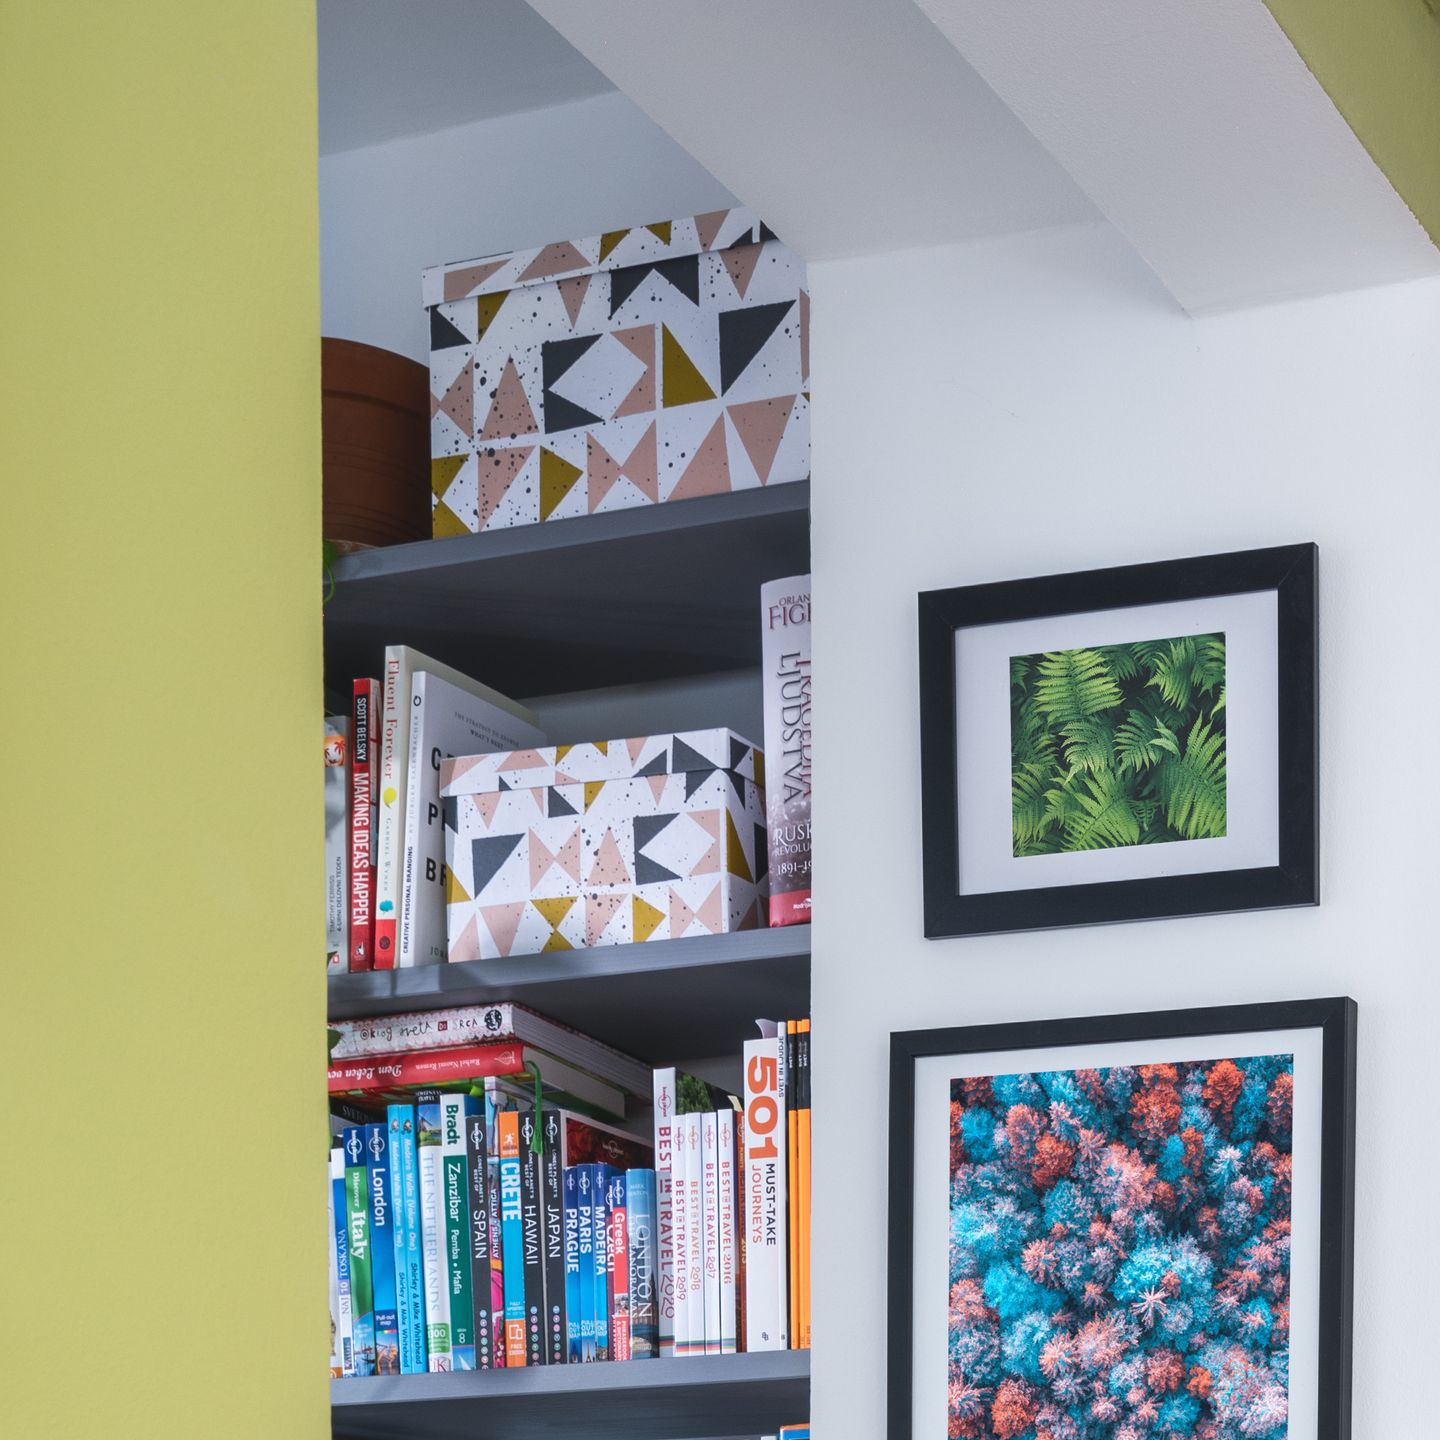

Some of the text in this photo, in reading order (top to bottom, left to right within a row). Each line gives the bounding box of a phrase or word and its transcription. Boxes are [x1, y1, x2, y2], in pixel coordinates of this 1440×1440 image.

[353, 772, 369, 926] MAKING IDEAS HAPPEN
[445, 1103, 459, 1145] Bradt
[747, 1055, 780, 1159] 501
[372, 1167, 389, 1226] London
[500, 1161, 520, 1222] CRETE
[751, 1165, 763, 1244] JOURNEYS
[765, 1162, 777, 1246] MUST-TAKE
[349, 1210, 365, 1259] Italy
[473, 1210, 486, 1259] SPAIN
[566, 1208, 579, 1273] PRAGUE
[581, 1205, 592, 1254] PARIS
